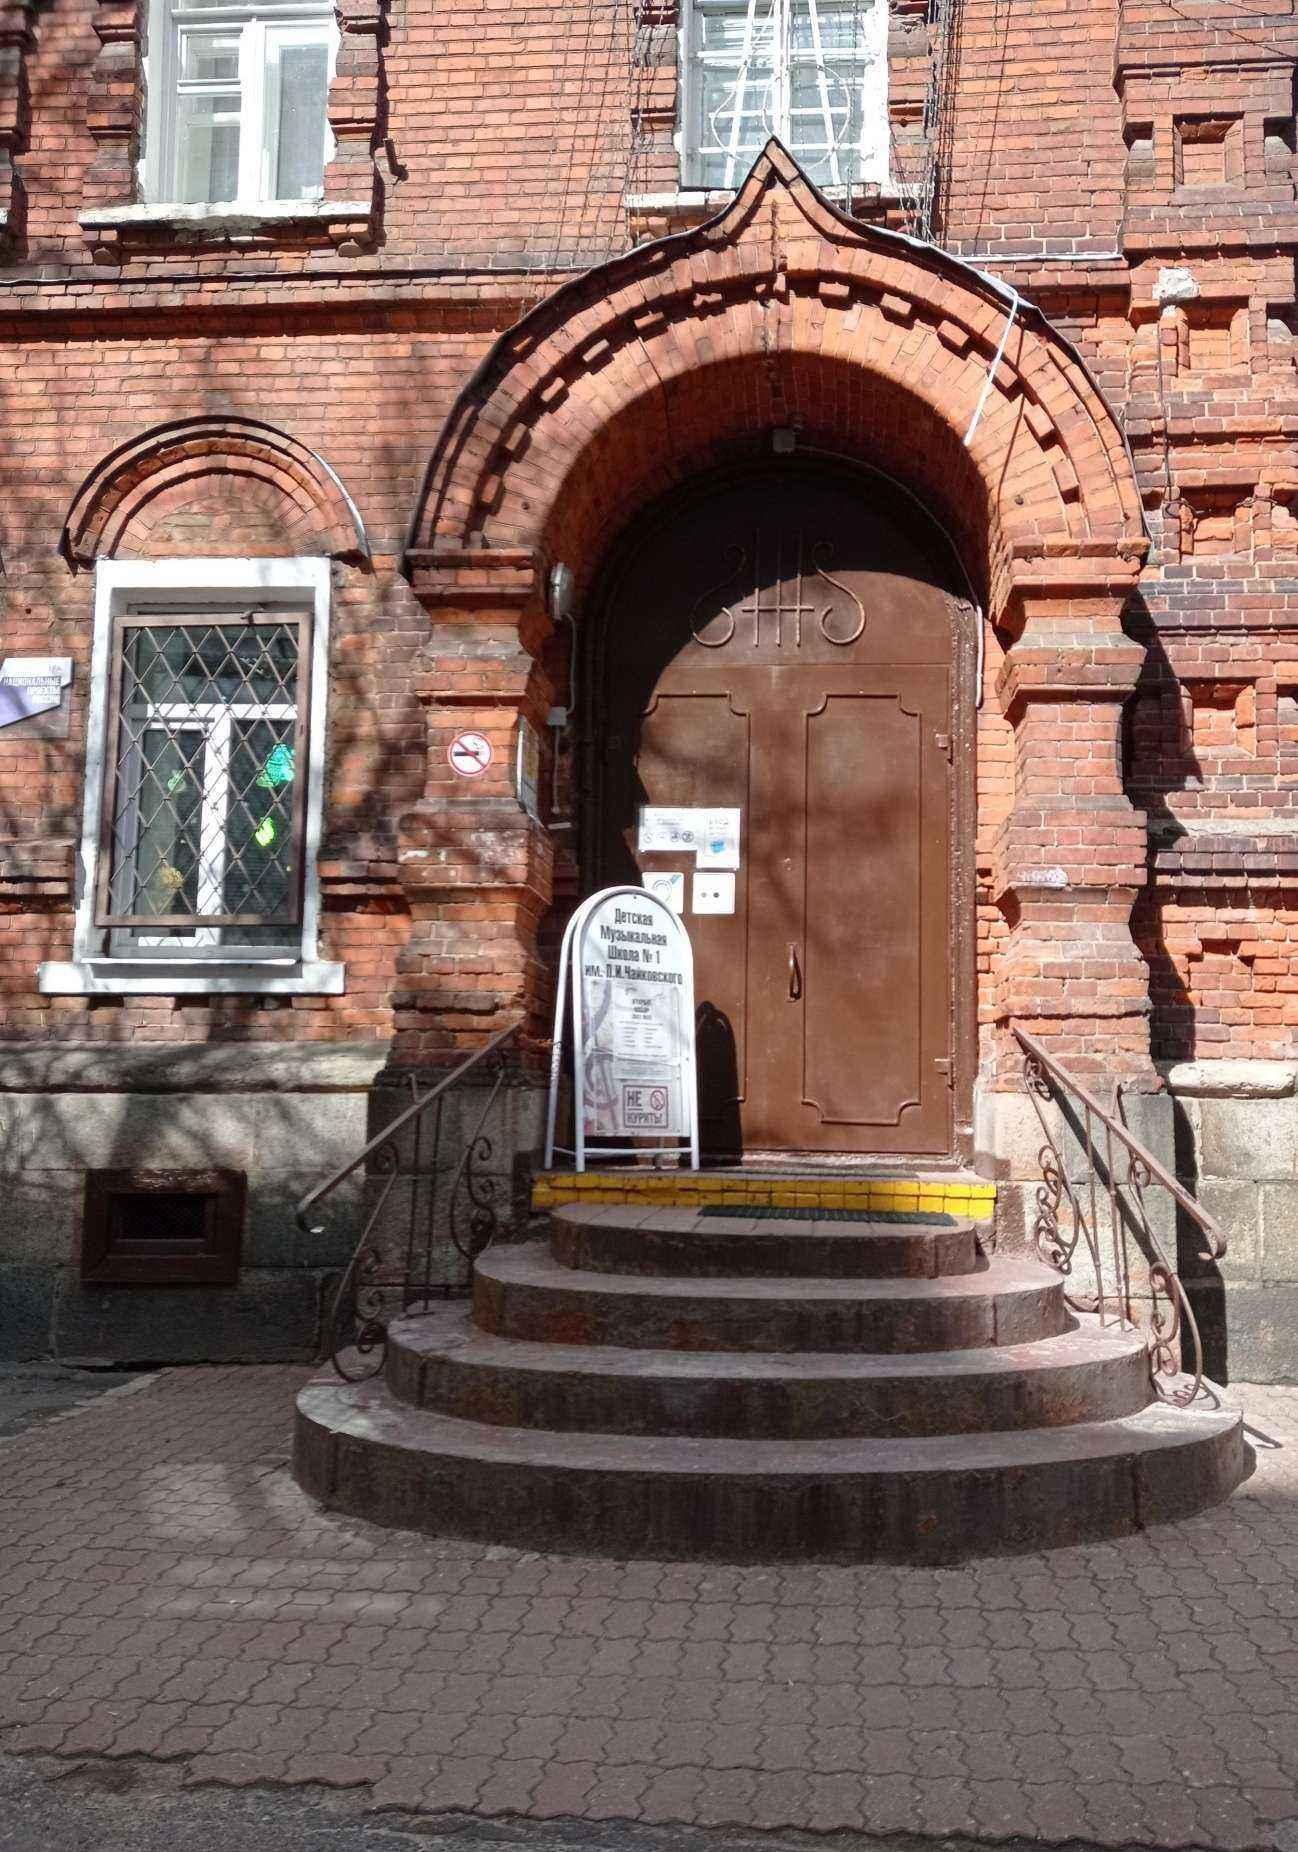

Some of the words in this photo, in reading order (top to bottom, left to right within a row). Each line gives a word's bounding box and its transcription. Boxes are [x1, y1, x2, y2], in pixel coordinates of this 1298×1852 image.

[615, 908, 653, 926] Детская
[600, 925, 667, 946] Музыкальная
[608, 945, 639, 962] Школа
[606, 963, 683, 985] П.И.Чайковского
[627, 1090, 642, 1107] НЕ
